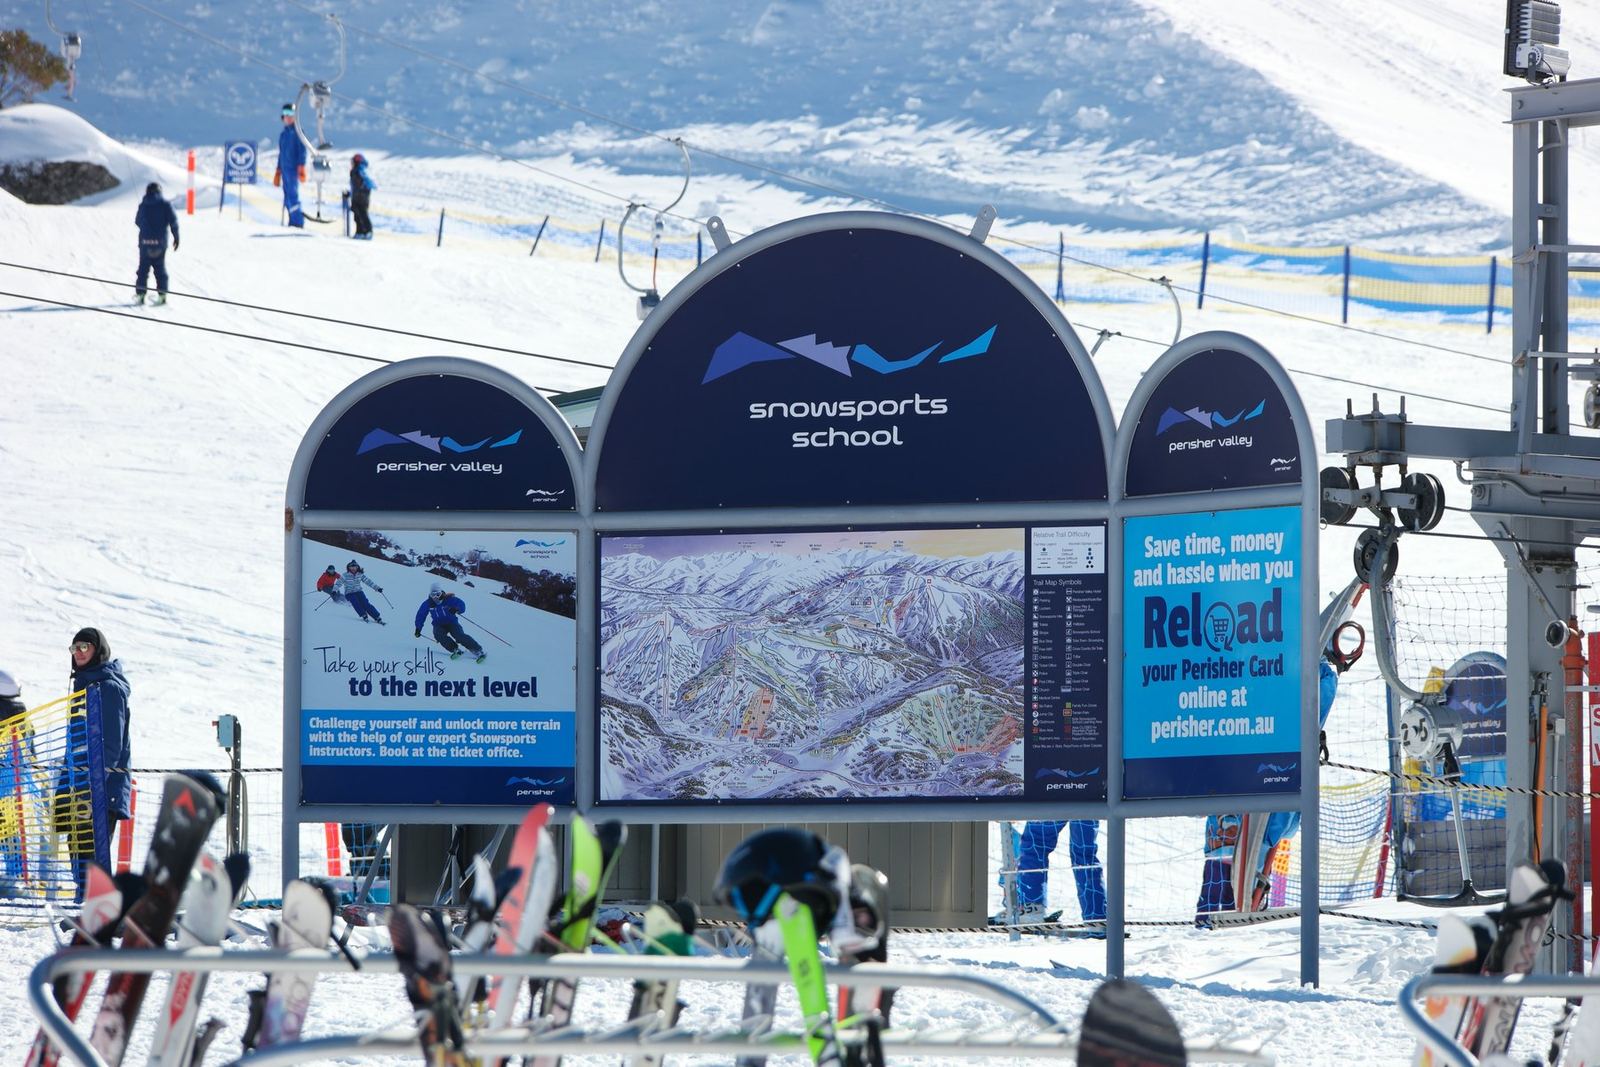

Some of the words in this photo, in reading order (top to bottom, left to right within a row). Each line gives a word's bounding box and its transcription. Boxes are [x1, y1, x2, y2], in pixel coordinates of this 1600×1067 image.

[750, 392, 948, 422] snowsports
[792, 425, 904, 448] school
[1168, 438, 1216, 454] perisher
[1218, 435, 1253, 448] valley
[376, 461, 446, 474] perisher
[450, 461, 503, 474] valley
[1144, 535, 1180, 558] Save
[1185, 532, 1226, 556] time,
[1231, 532, 1284, 554] money
[1133, 563, 1162, 587] and
[1167, 560, 1215, 585] hassle
[1218, 559, 1260, 582] when
[1264, 560, 1294, 584] you
[313, 646, 358, 674] Take
[363, 660, 400, 682] your
[404, 647, 446, 676] skills
[1142, 664, 1177, 687] your
[1182, 656, 1244, 680] Perisher
[1250, 653, 1284, 677] Card
[349, 678, 372, 697] to
[380, 676, 418, 697] the
[424, 678, 476, 697] next
[483, 676, 538, 698] level
[1179, 685, 1227, 709] online
[1231, 686, 1247, 707] at
[309, 717, 366, 731] Challenge
[370, 718, 417, 731] yourself
[420, 718, 442, 730] and
[445, 719, 483, 730] unlock
[487, 721, 517, 730] more
[521, 719, 560, 730] terrain
[1151, 714, 1274, 744] perisher.com.au
[309, 732, 334, 742] with
[338, 732, 358, 743] the
[360, 732, 386, 745] help
[390, 732, 403, 743] of
[405, 734, 425, 743] our
[428, 733, 467, 746] expert
[470, 732, 536, 746] Snowsports
[309, 746, 375, 757] instructors.
[380, 746, 409, 757] Book
[412, 748, 424, 757] at
[427, 746, 447, 757] the
[450, 746, 483, 758] ticket
[486, 746, 523, 758] office.
[1046, 782, 1088, 791] perisher
[1264, 776, 1290, 784] perisher
[516, 788, 555, 797] perisher
